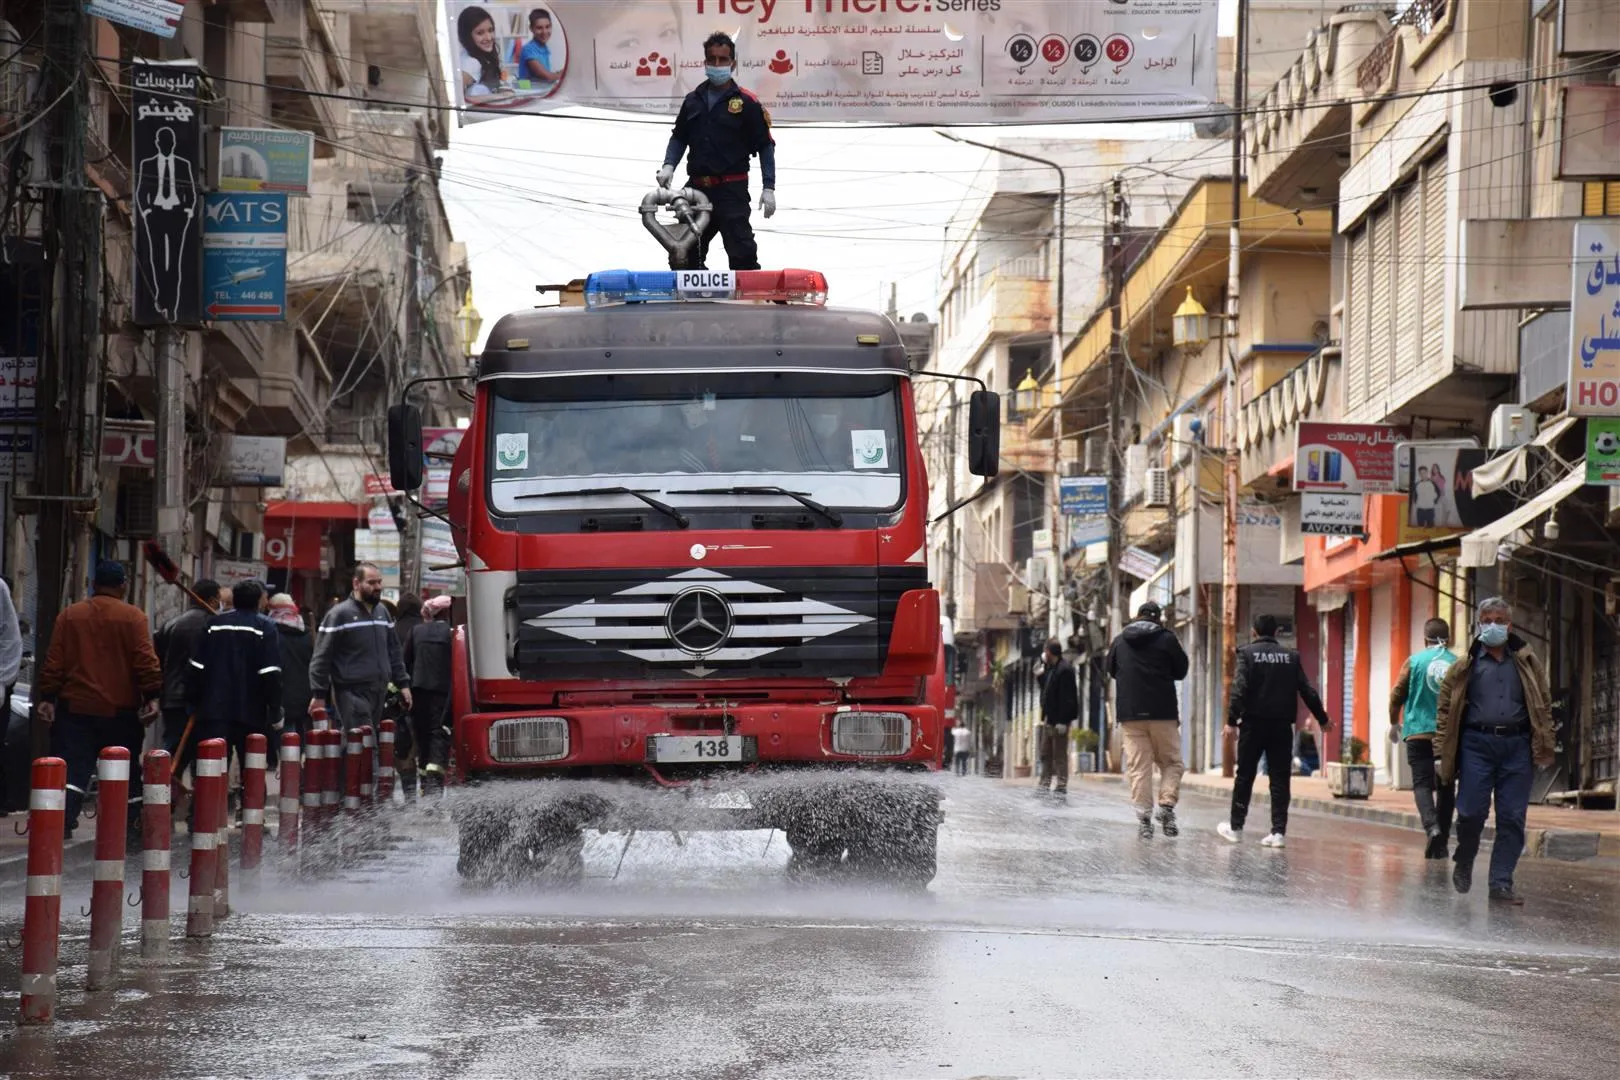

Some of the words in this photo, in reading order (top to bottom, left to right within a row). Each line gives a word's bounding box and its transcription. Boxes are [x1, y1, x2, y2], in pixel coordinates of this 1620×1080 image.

[936, 0, 1001, 12] Series
[843, 25, 868, 34] اللغة
[869, 25, 902, 36] لتعليم
[904, 26, 942, 34] سلسلة
[928, 48, 964, 62] التركيز
[946, 63, 963, 75] كل
[1144, 58, 1177, 70] المراحل
[898, 65, 919, 77] على
[922, 66, 942, 77] درس
[135, 72, 194, 92] ملبوسات
[138, 98, 194, 122] هيثم
[683, 273, 729, 288] POLICE
[215, 291, 231, 300] TEL
[1307, 523, 1353, 536] AVOCAT
[694, 740, 729, 757] 138
